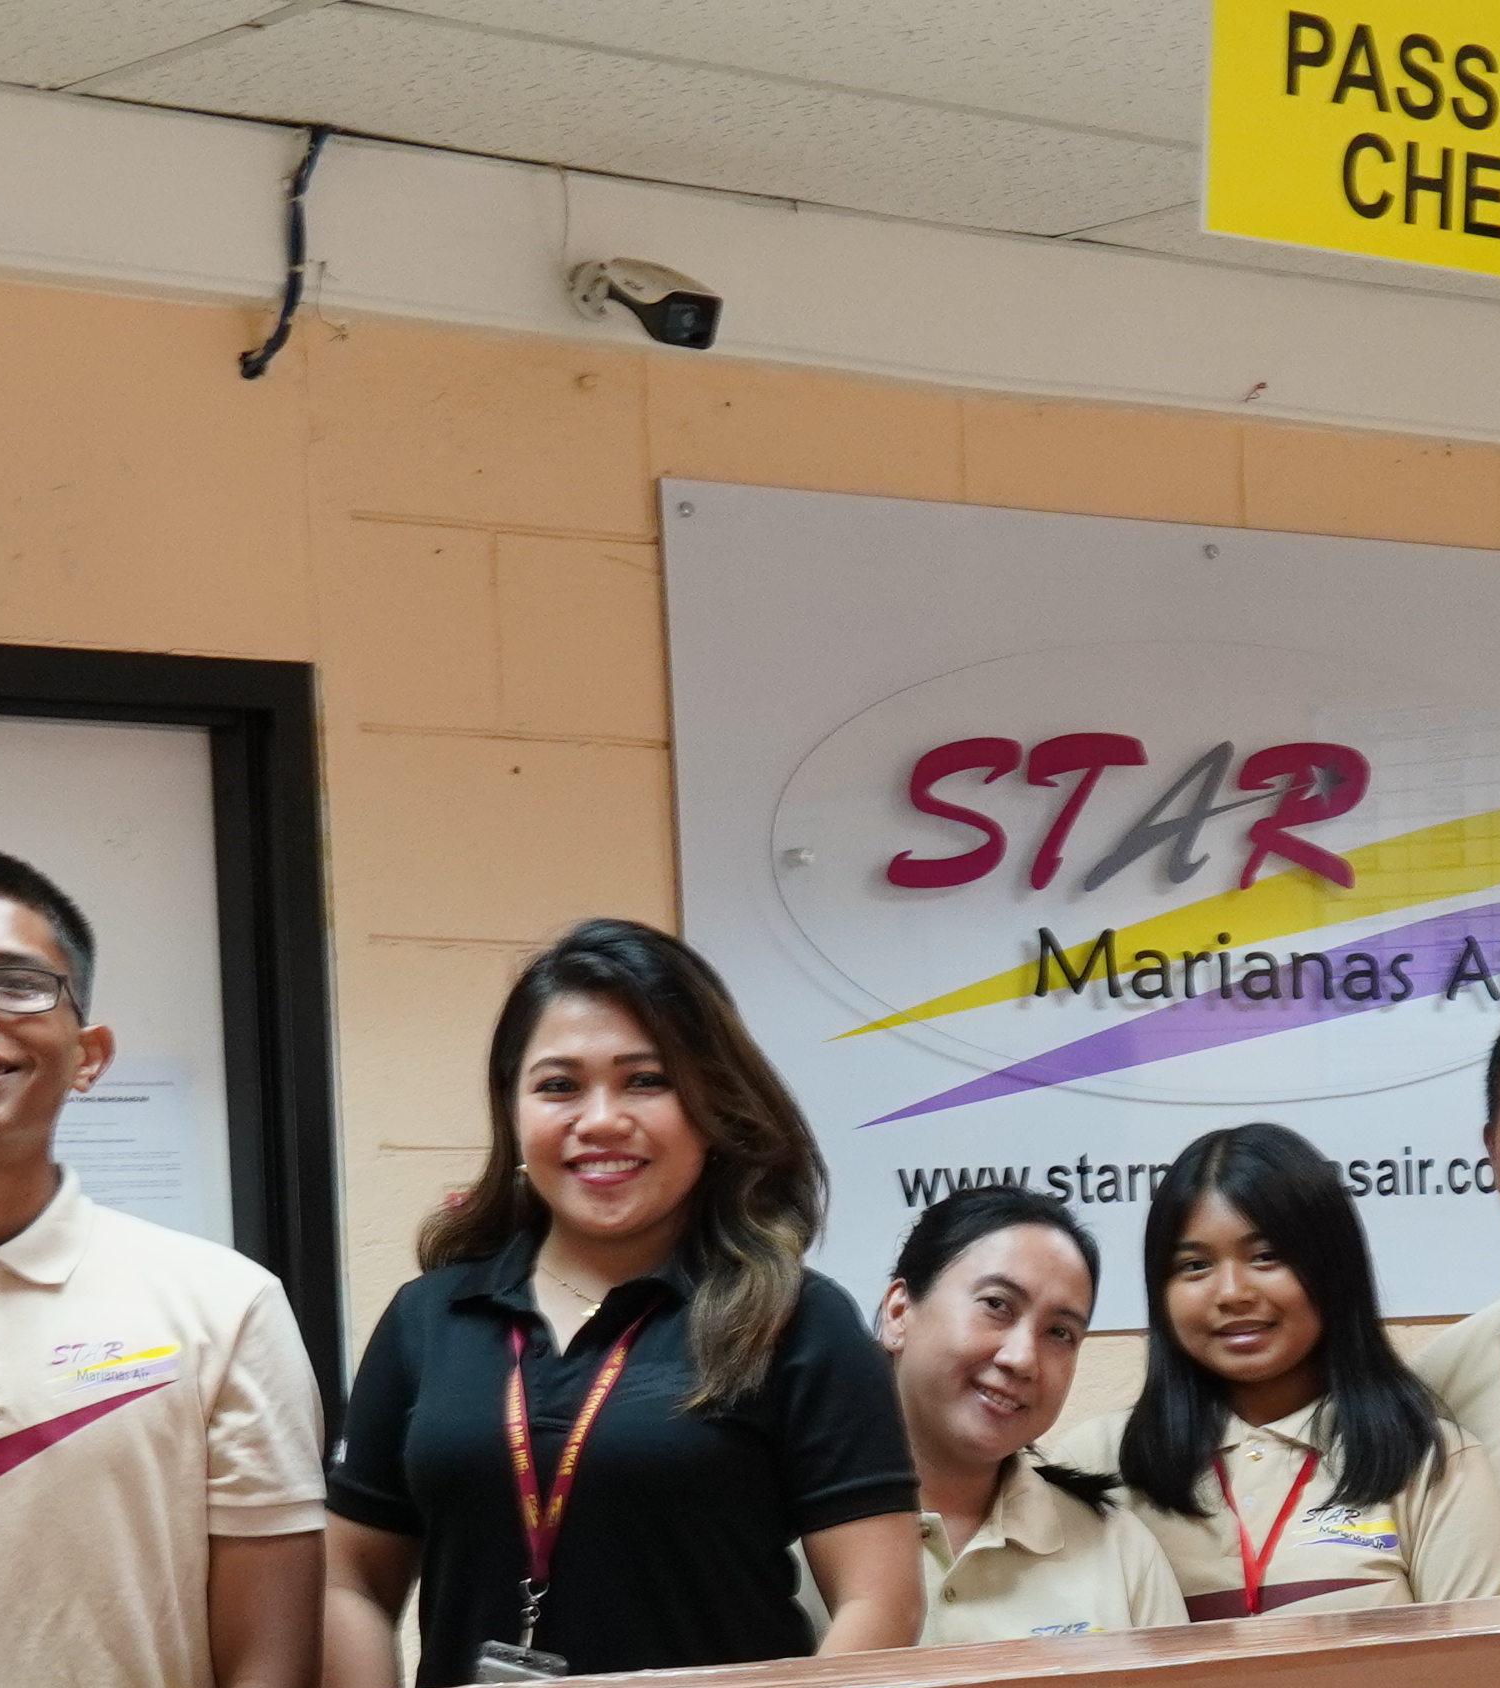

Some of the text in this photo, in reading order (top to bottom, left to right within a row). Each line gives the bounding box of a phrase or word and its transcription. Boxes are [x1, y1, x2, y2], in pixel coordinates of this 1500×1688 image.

[886, 731, 1371, 892] STAR
[1032, 927, 1414, 1001] Marianas
[898, 1147, 1499, 1207] www.starsair.co
[50, 1341, 124, 1365] STAR
[76, 1368, 150, 1381] Marianas Air
[1302, 1506, 1361, 1528] STAR
